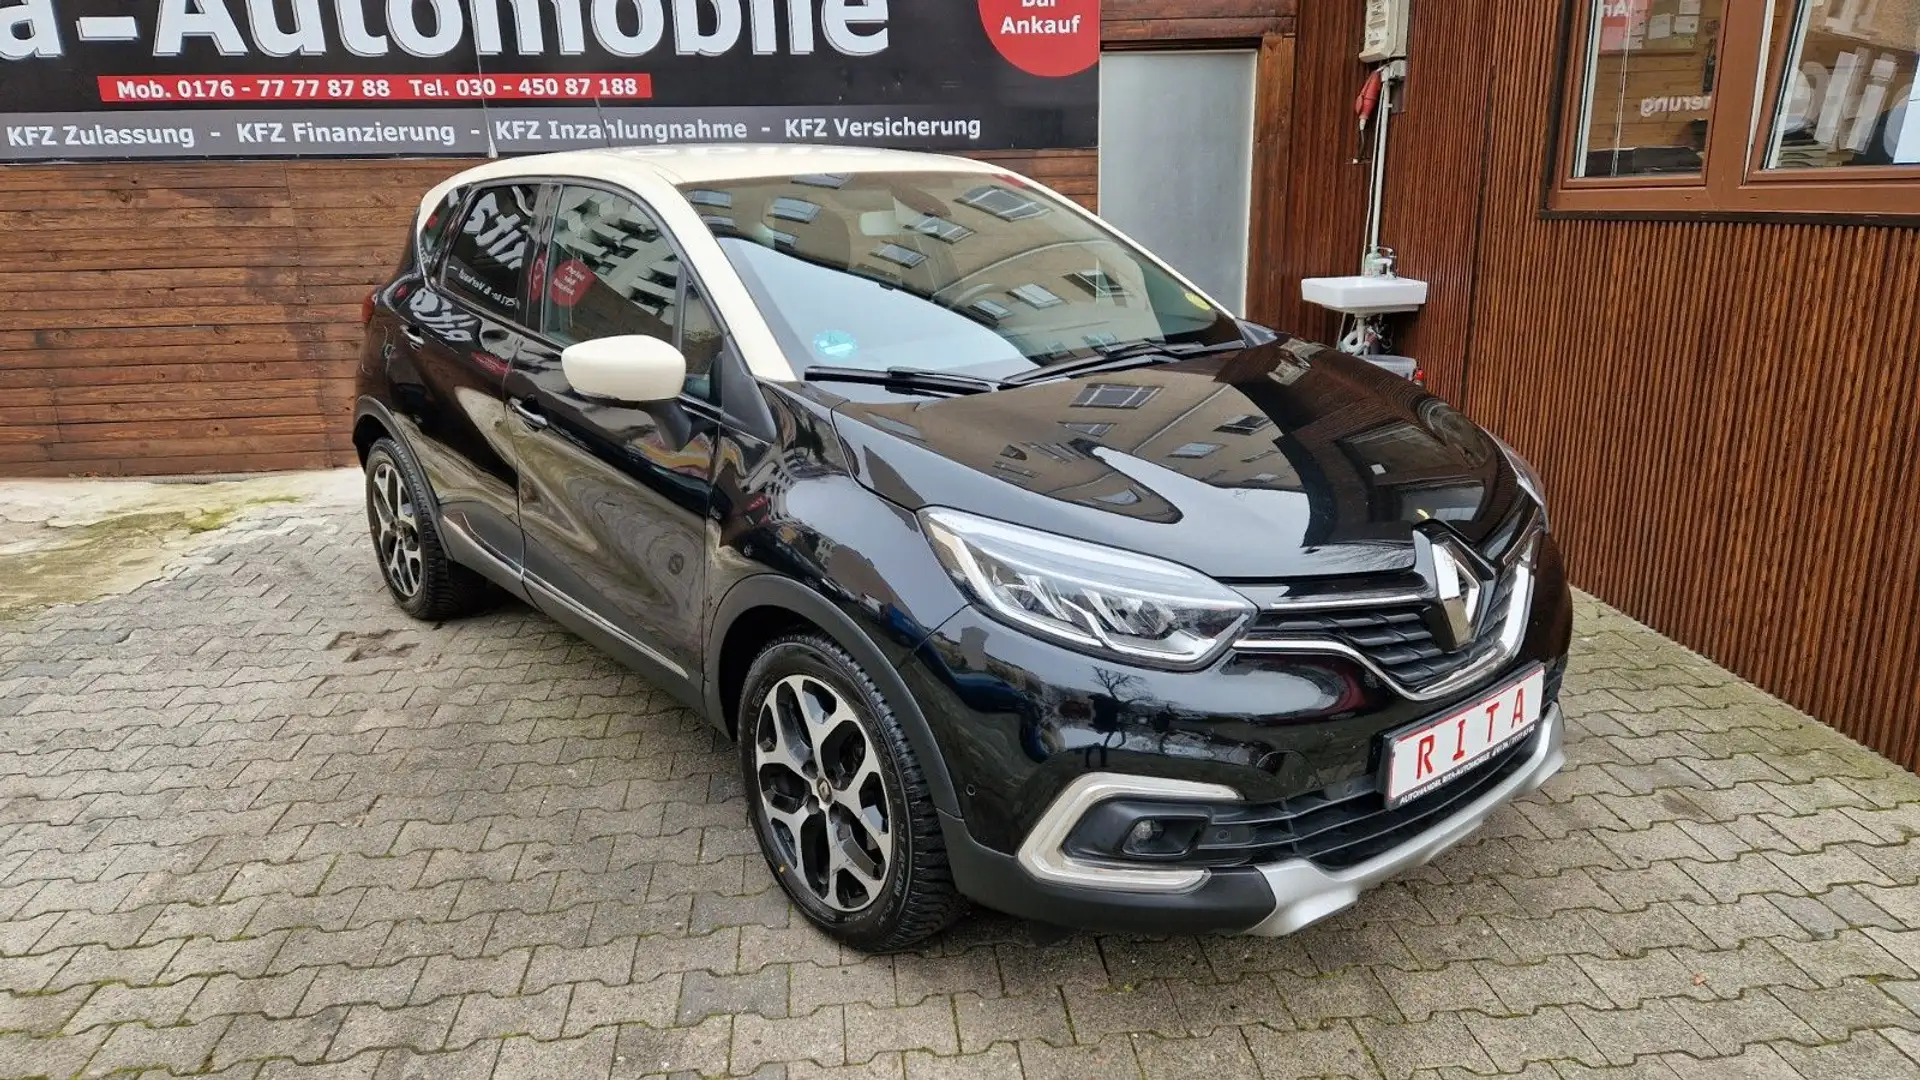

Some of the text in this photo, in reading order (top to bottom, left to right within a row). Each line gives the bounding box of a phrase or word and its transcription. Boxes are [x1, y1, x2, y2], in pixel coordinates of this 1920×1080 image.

[1000, 15, 1081, 34] Ankauf
[117, 80, 172, 99] Mob.
[177, 80, 235, 98] 0176
[257, 79, 285, 97] 77
[292, 79, 319, 97] 77
[327, 79, 354, 97] 87
[362, 79, 390, 97] 88
[408, 79, 450, 97] Tel.
[455, 79, 496, 97] 030
[518, 79, 559, 96] 450
[565, 78, 591, 95] 87
[599, 78, 638, 96] 188
[6, 126, 57, 147] KFZ
[62, 124, 195, 149] Zulassung
[236, 123, 286, 143] KFZ
[292, 122, 456, 146] Finanzierung
[495, 121, 541, 140] KFZ
[548, 119, 748, 143] Inzahlungnahme
[785, 118, 828, 138] KFZ
[833, 117, 982, 139] Versicherung
